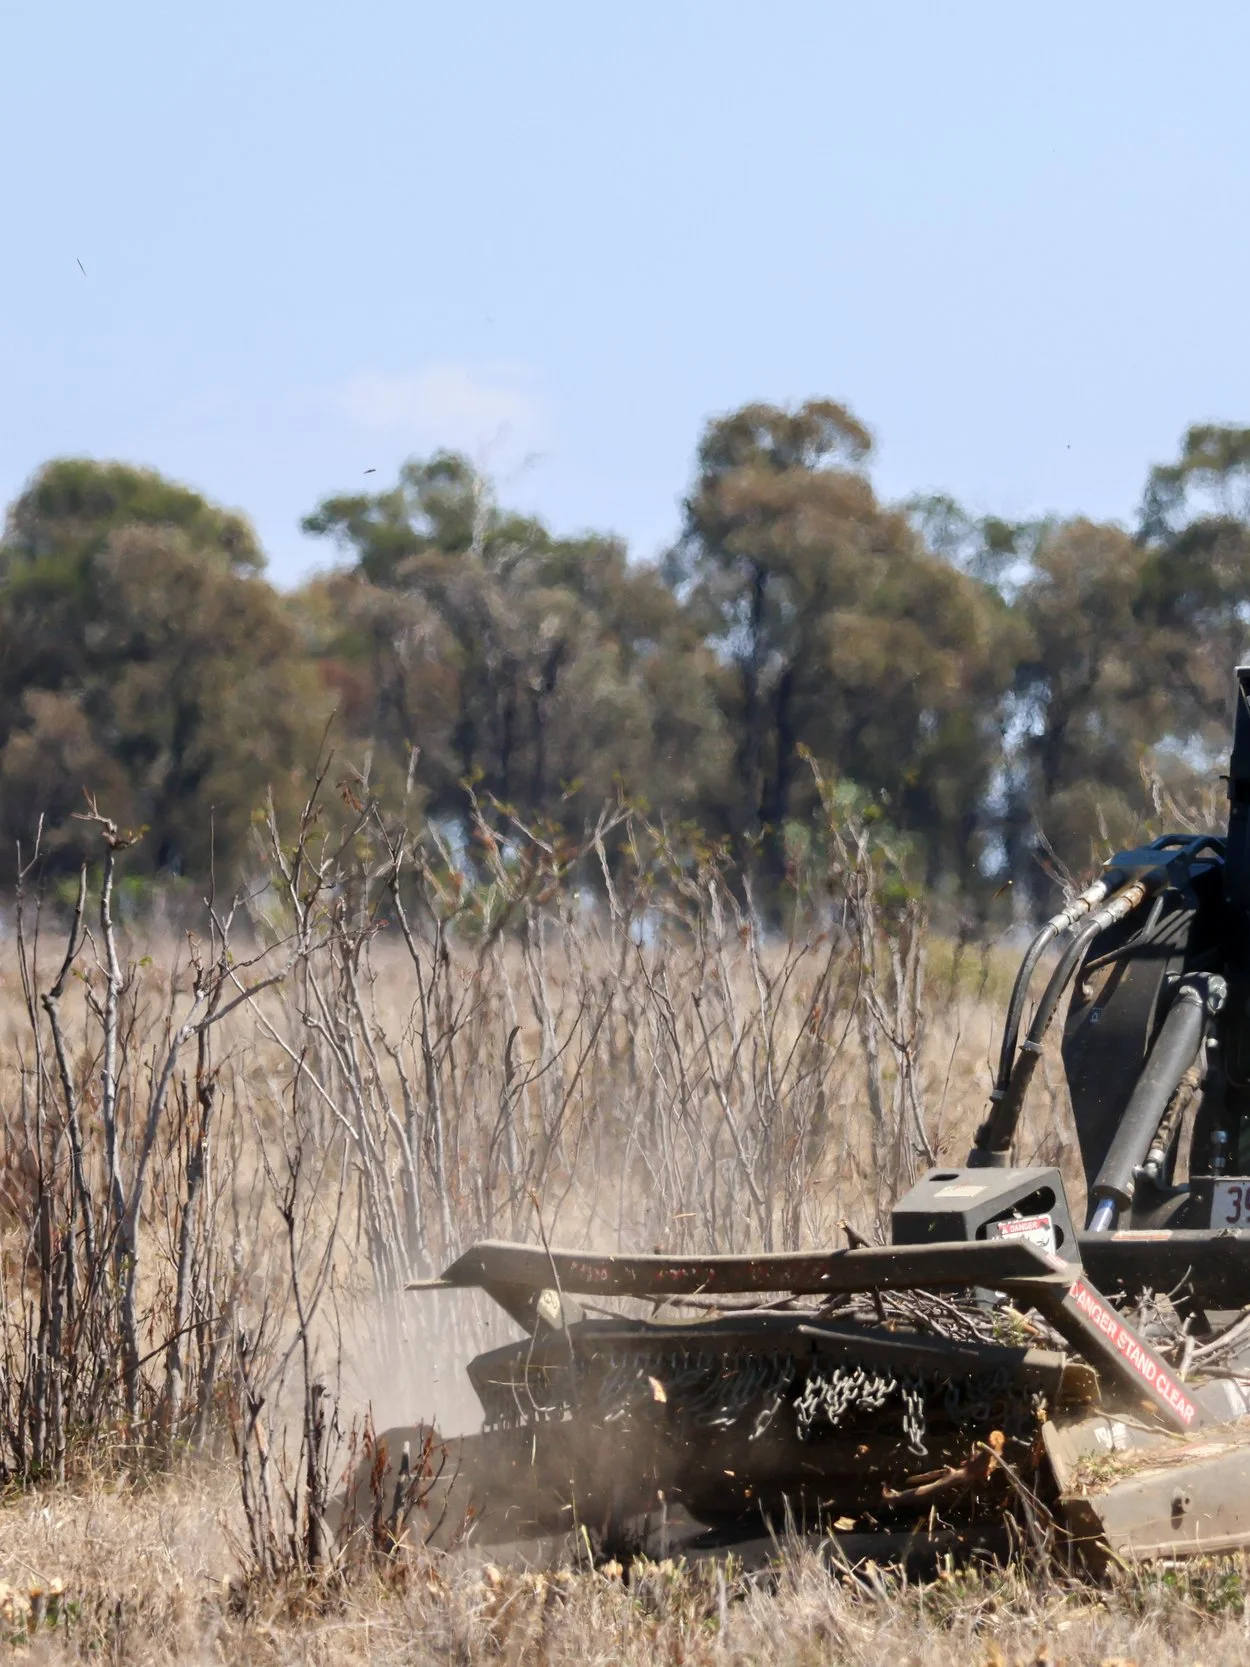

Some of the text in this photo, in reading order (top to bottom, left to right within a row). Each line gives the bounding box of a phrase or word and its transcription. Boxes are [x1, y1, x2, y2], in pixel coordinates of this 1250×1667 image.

[1010, 1221, 1039, 1233] DANGER
[1069, 1282, 1195, 1424] DANGER STAND CLEAR
